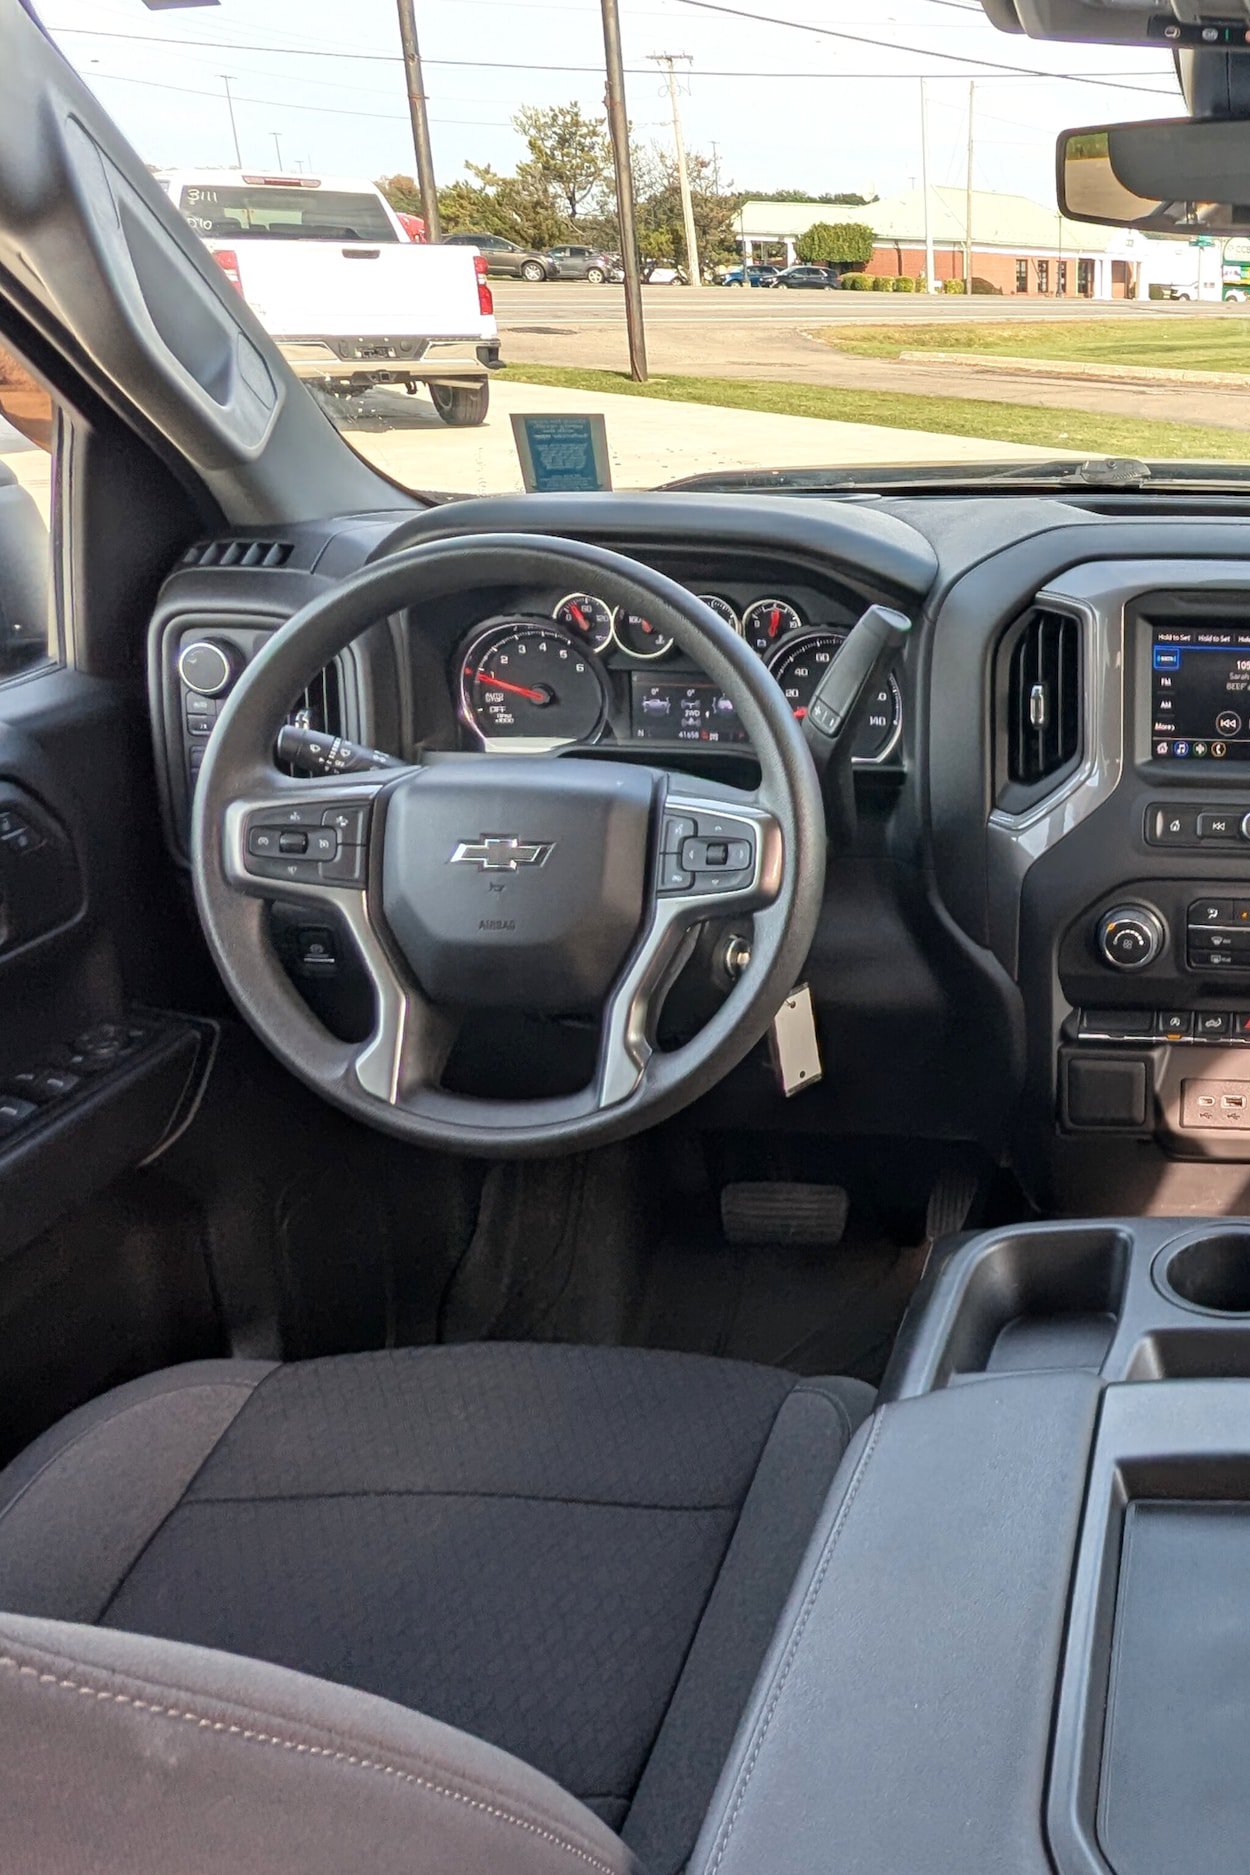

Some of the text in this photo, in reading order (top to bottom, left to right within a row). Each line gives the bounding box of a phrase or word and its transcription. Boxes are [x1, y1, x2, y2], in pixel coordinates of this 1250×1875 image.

[518, 644, 526, 654] 3
[539, 642, 547, 652] 4
[560, 649, 568, 659] 5
[500, 655, 509, 664] 2
[576, 663, 584, 672] 6
[1237, 660, 1250, 670] 105
[794, 667, 809, 676] 40
[1229, 672, 1250, 680] Sarah
[869, 716, 886, 726] 140
